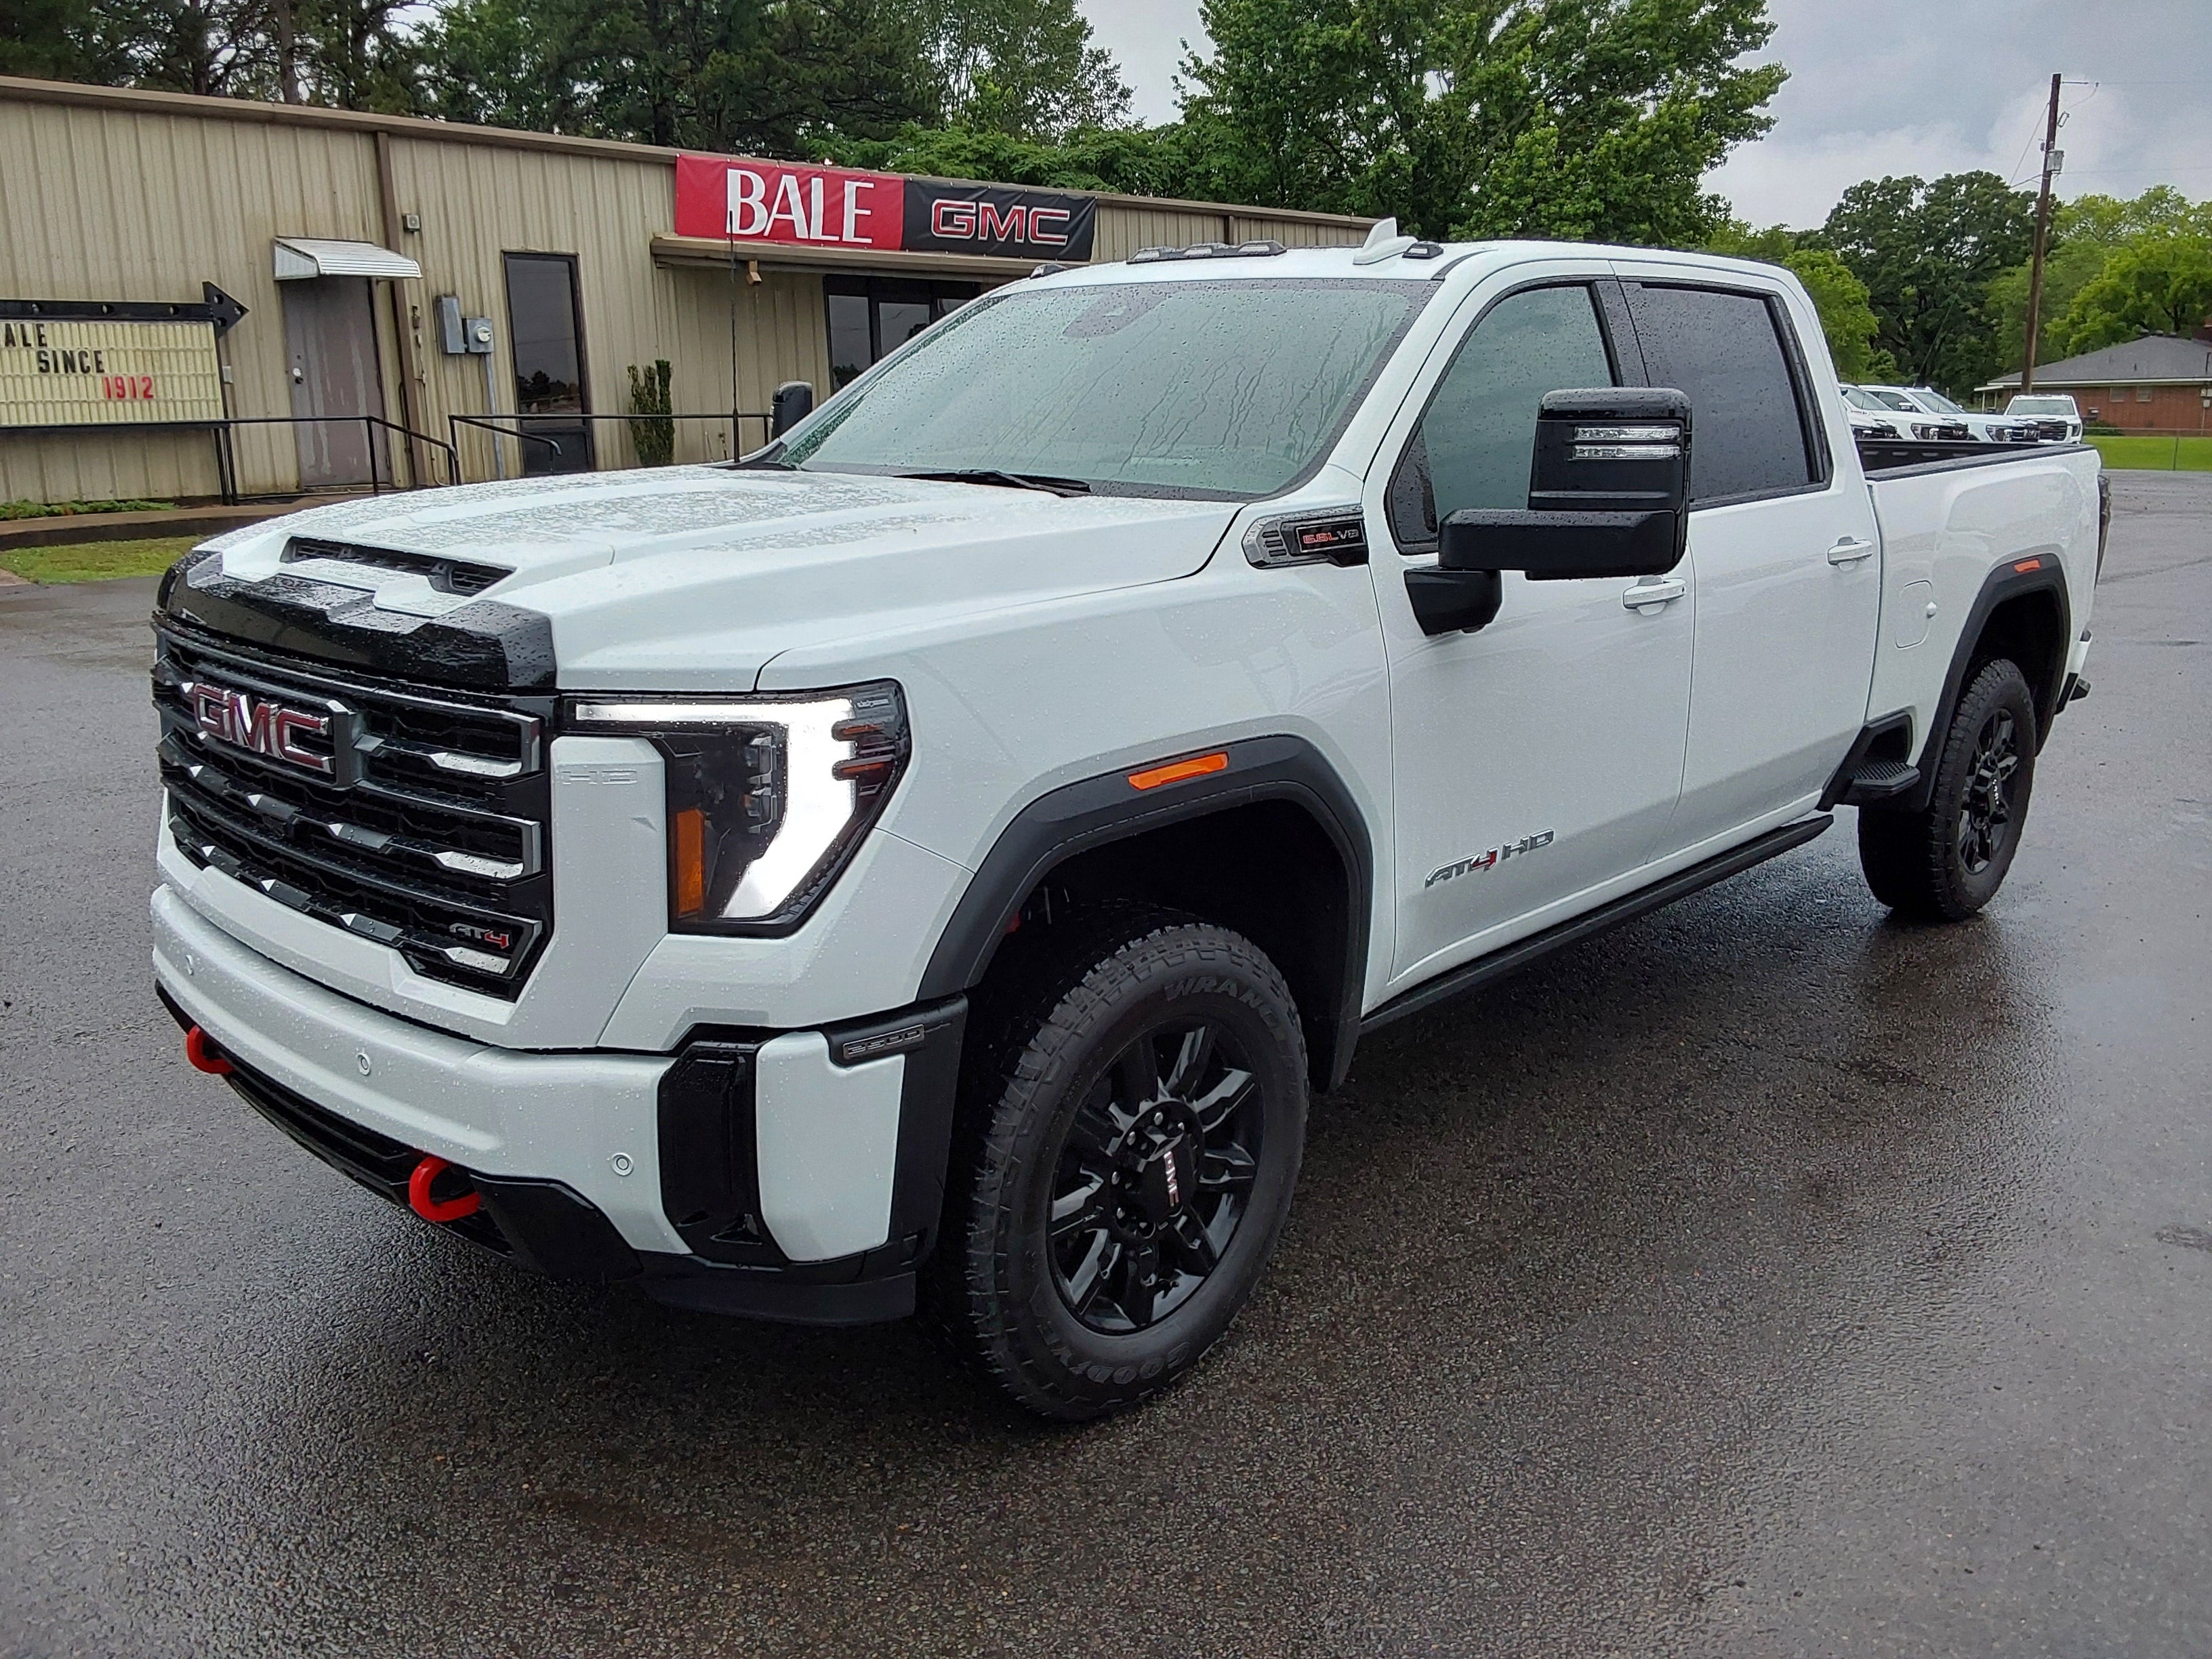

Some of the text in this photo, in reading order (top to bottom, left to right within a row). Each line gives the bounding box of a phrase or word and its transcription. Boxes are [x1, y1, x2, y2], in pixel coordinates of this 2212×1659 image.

[726, 168, 1071, 246] BALE GMC
[37, 350, 105, 374] SINCE
[104, 376, 154, 400] 1912
[193, 682, 335, 774] GMC
[1425, 828, 1555, 890] AT4 HD
[448, 922, 510, 949] AT4
[848, 1029, 921, 1055] 2500
